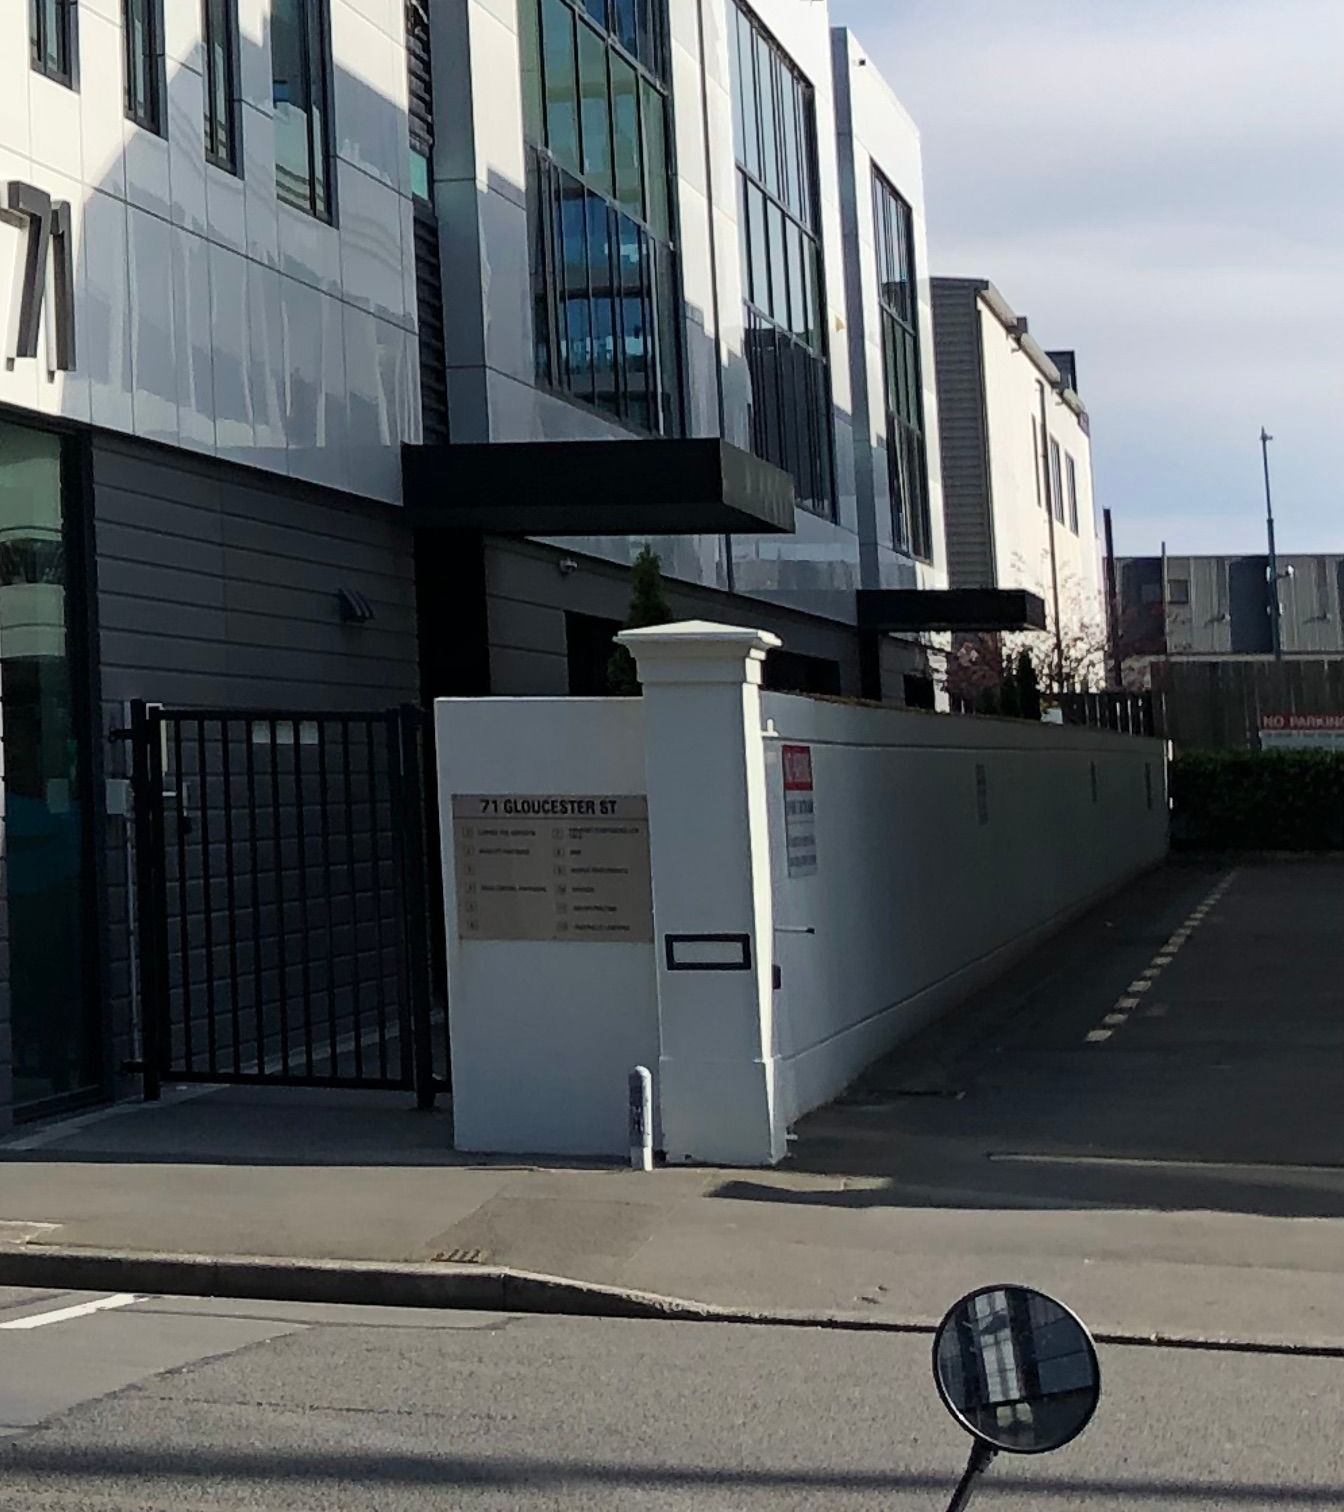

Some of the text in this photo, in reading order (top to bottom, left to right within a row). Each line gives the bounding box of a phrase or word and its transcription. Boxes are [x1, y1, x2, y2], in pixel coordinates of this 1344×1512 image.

[1263, 715, 1285, 727] NO
[480, 798, 618, 815] 71 GLOUCESTER ST
